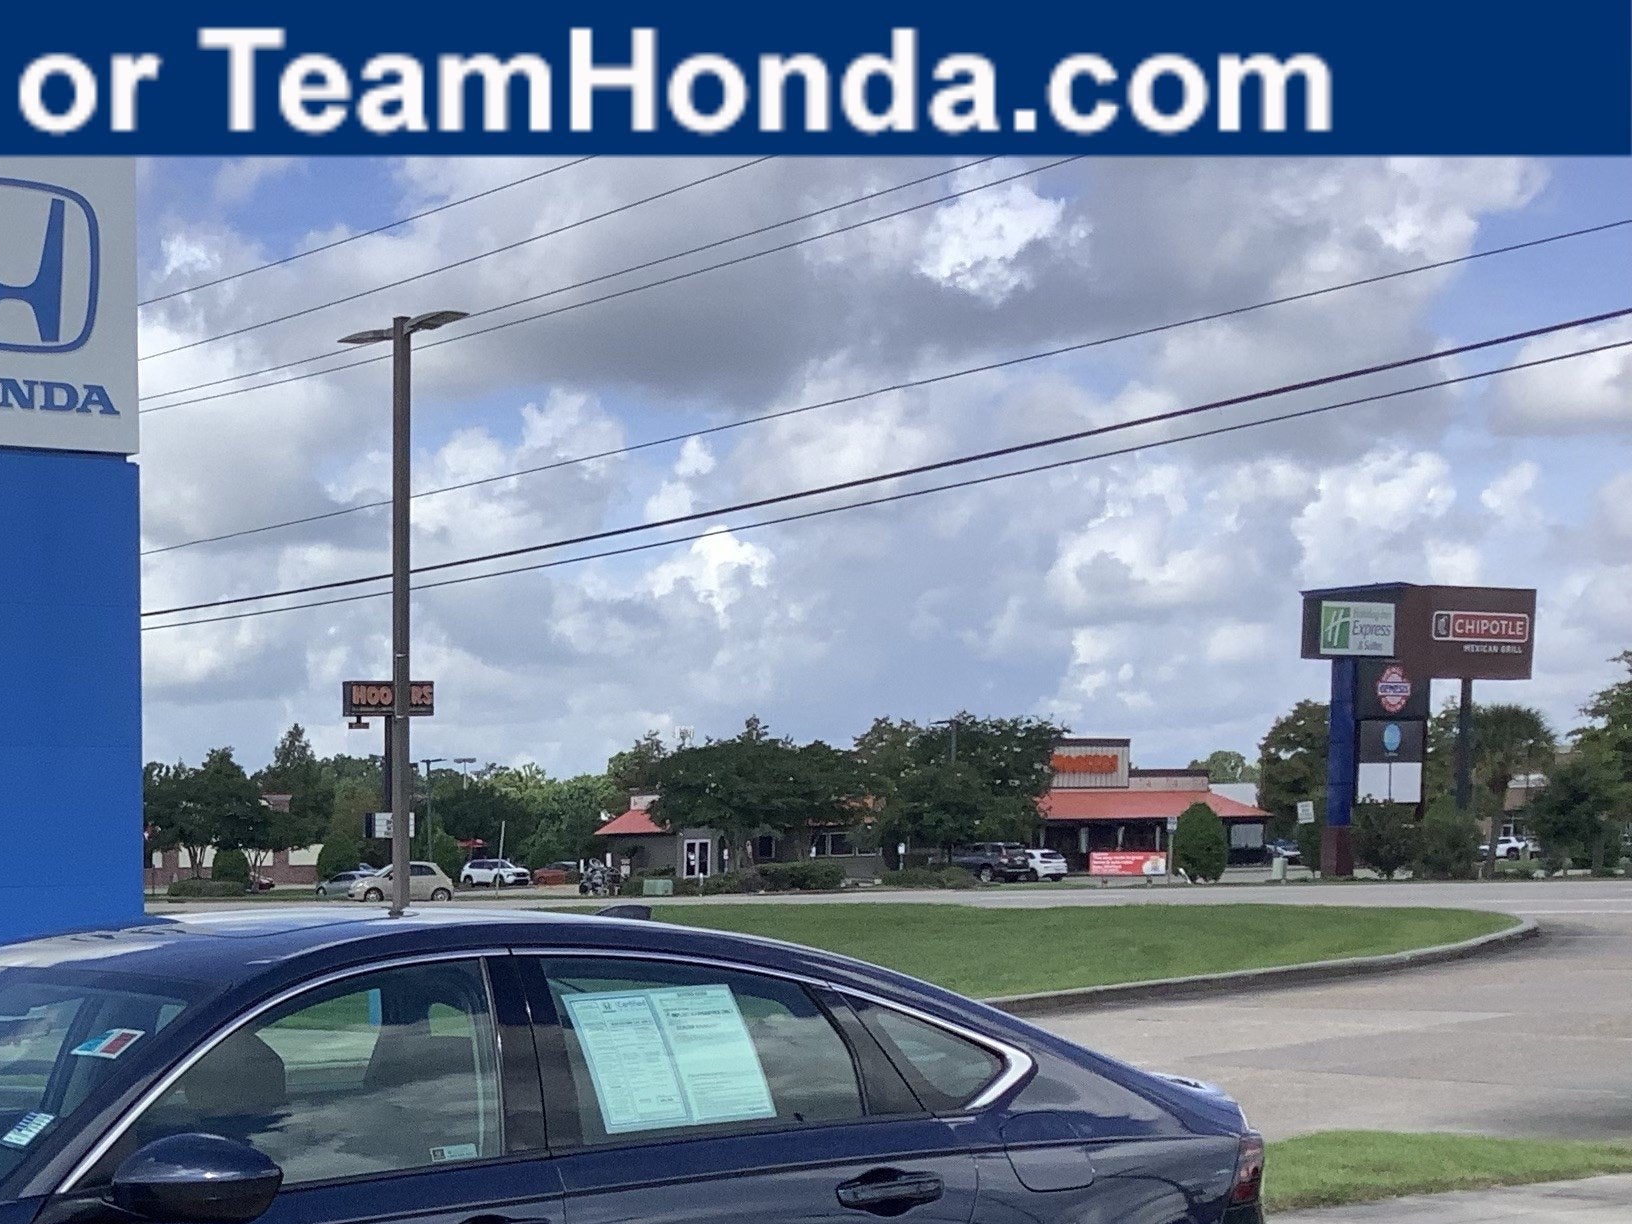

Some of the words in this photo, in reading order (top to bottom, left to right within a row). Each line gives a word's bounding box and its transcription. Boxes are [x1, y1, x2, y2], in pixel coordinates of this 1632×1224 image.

[1352, 620, 1392, 639] Express
[1454, 619, 1524, 636] CHIPOTLE
[1463, 644, 1499, 653] MEXICAN
[1500, 645, 1523, 654] GRILL
[352, 684, 433, 706] HOORS
